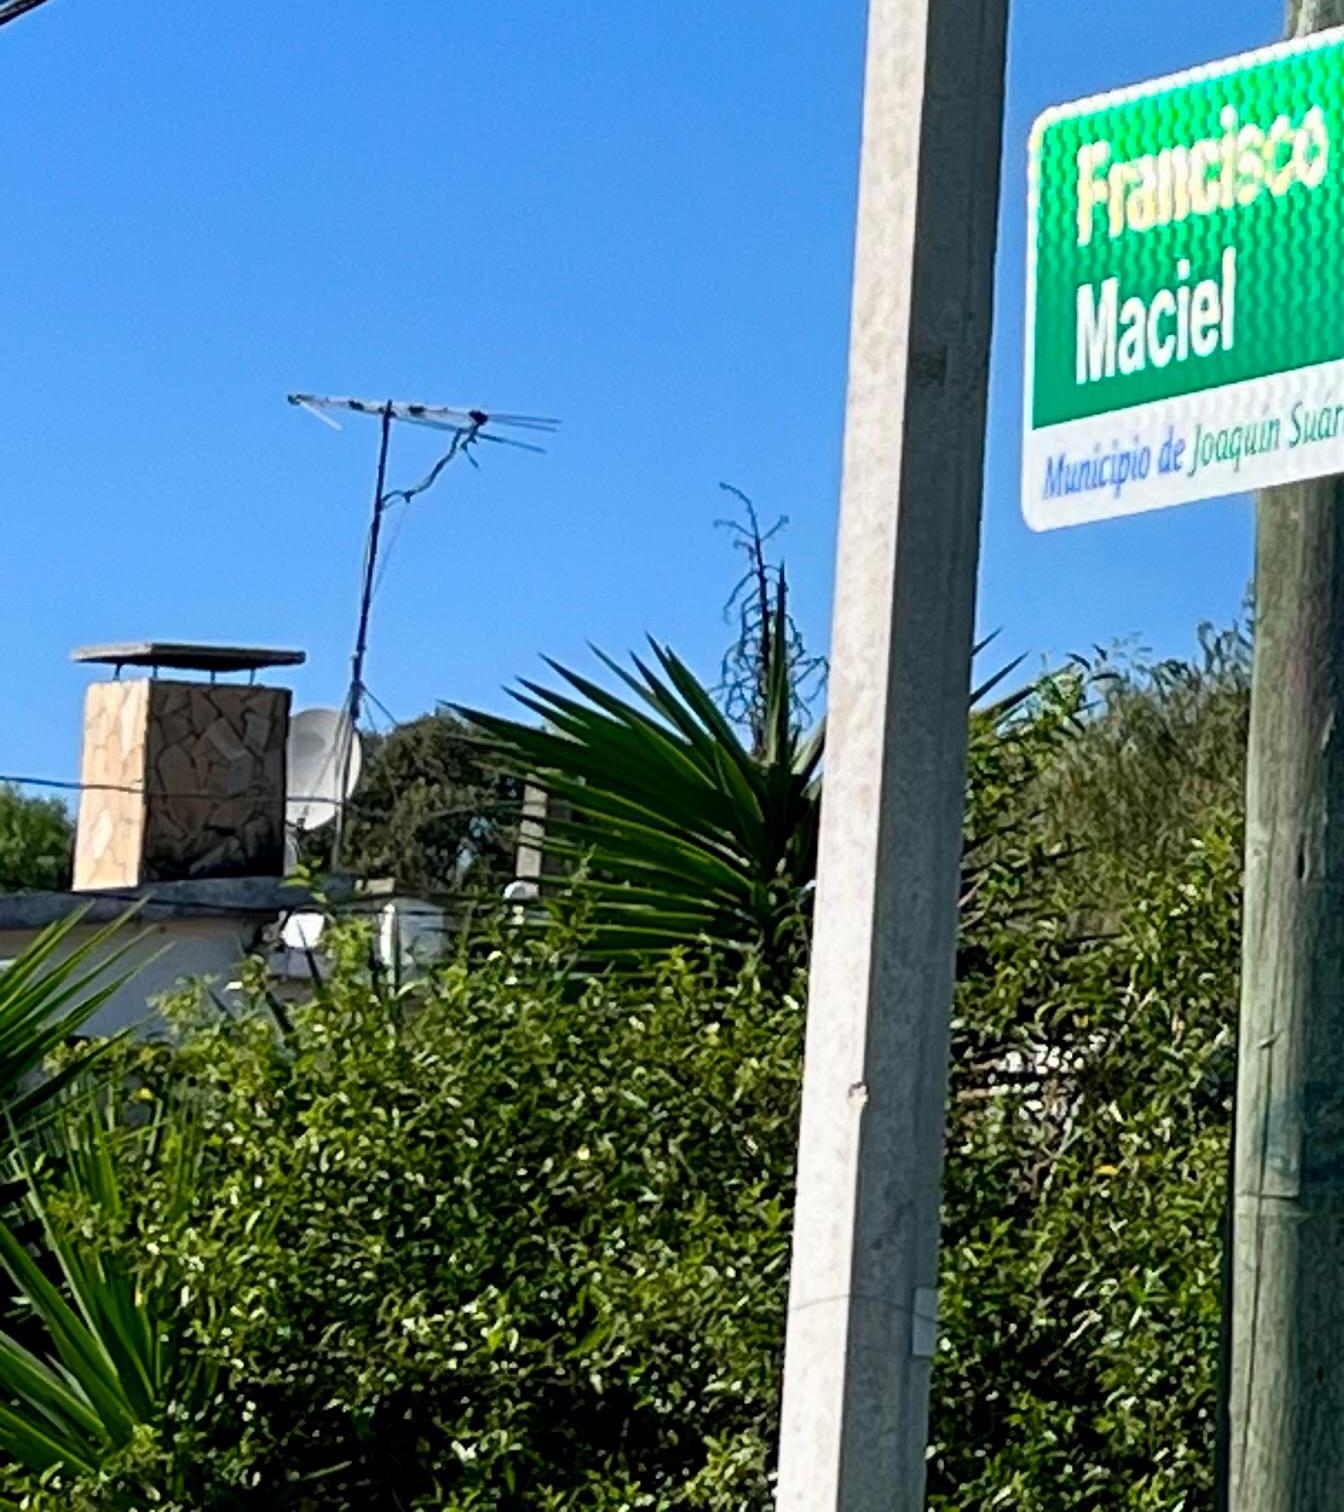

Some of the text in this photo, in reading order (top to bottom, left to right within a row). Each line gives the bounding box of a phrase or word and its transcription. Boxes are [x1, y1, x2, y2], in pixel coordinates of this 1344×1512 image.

[1076, 104, 1329, 247] Francisco
[1076, 245, 1236, 385] Maciel
[1041, 434, 1151, 500] Municipio
[1157, 424, 1185, 473] de
